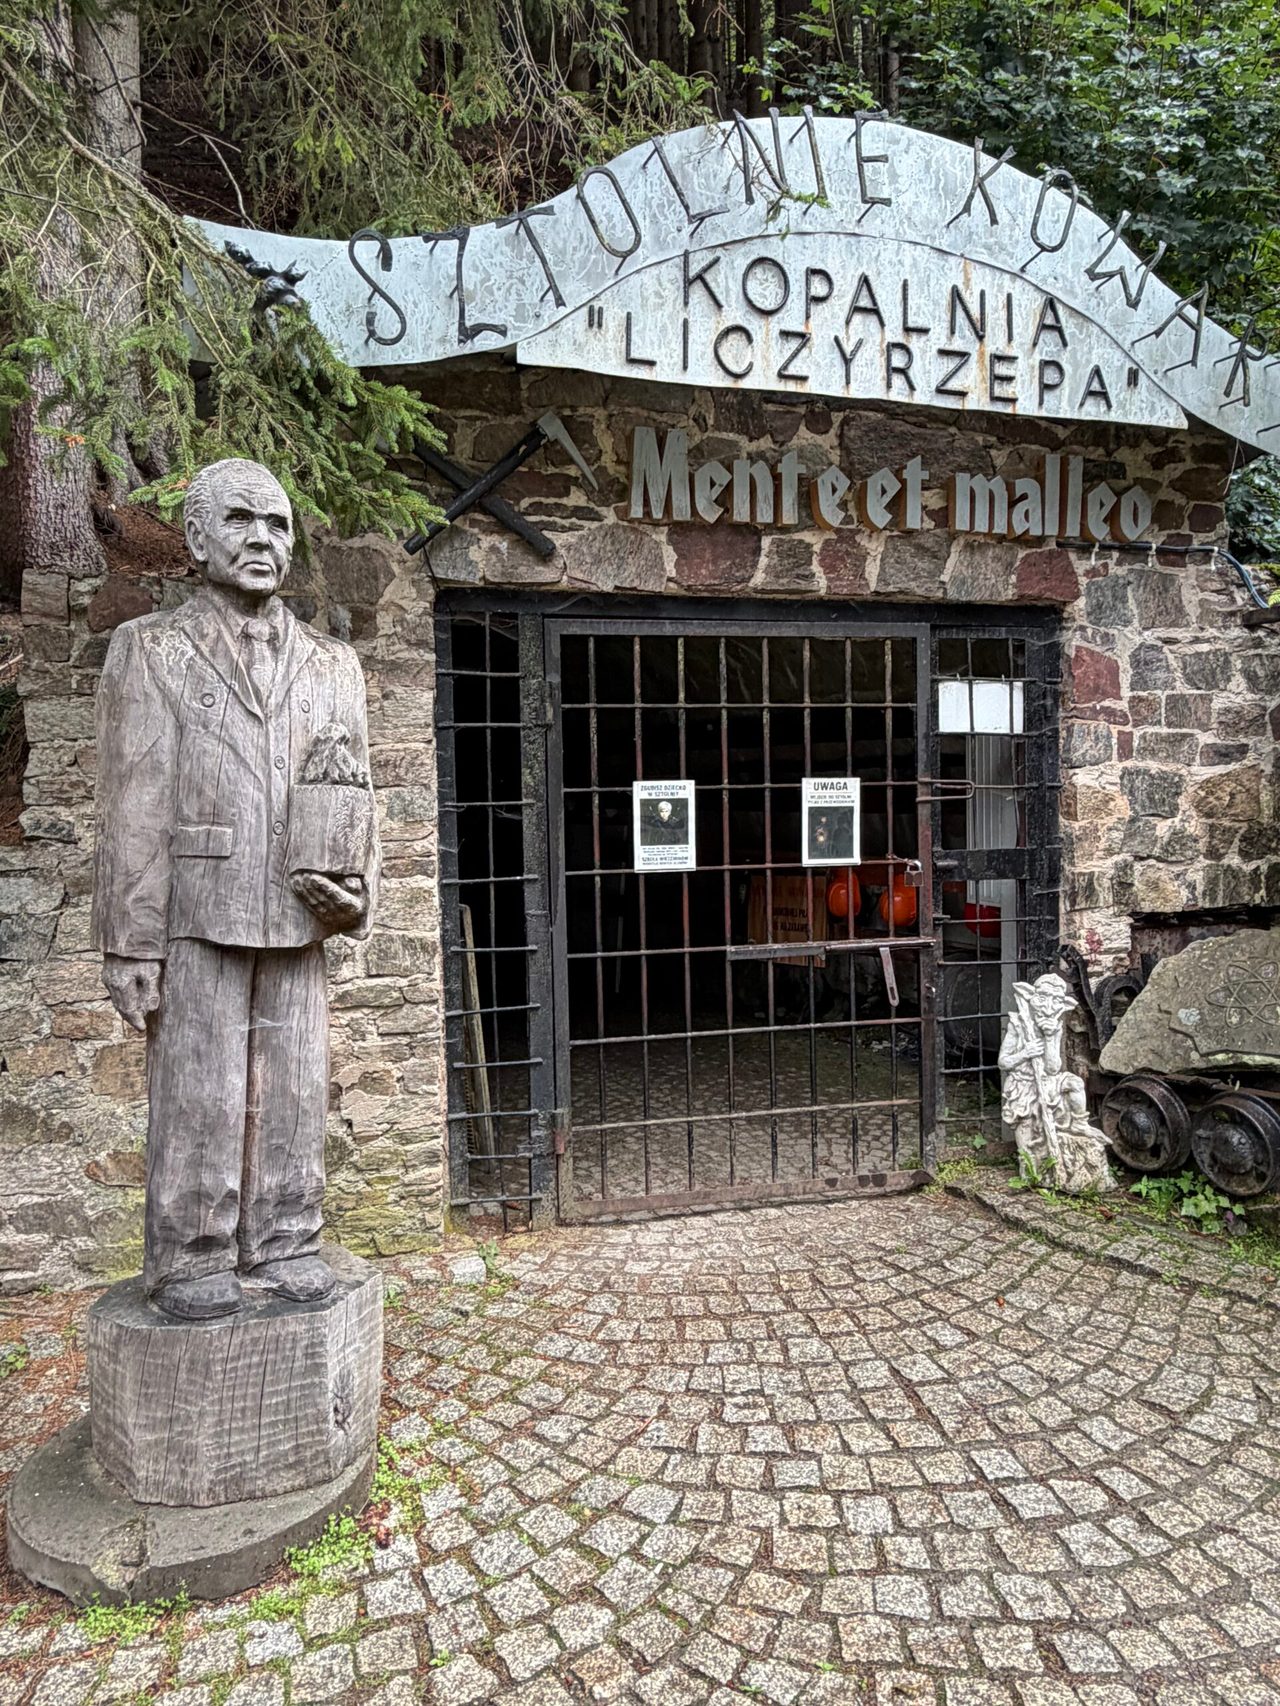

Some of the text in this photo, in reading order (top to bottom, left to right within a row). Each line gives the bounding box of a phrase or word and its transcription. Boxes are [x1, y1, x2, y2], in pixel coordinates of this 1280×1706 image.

[348, 105, 1270, 408] SZTOLNIE KOWAR
[682, 248, 1069, 349] KOPALNIA
[866, 455, 929, 530] et
[955, 453, 1151, 541] malleo
[813, 781, 848, 791] UWAGA
